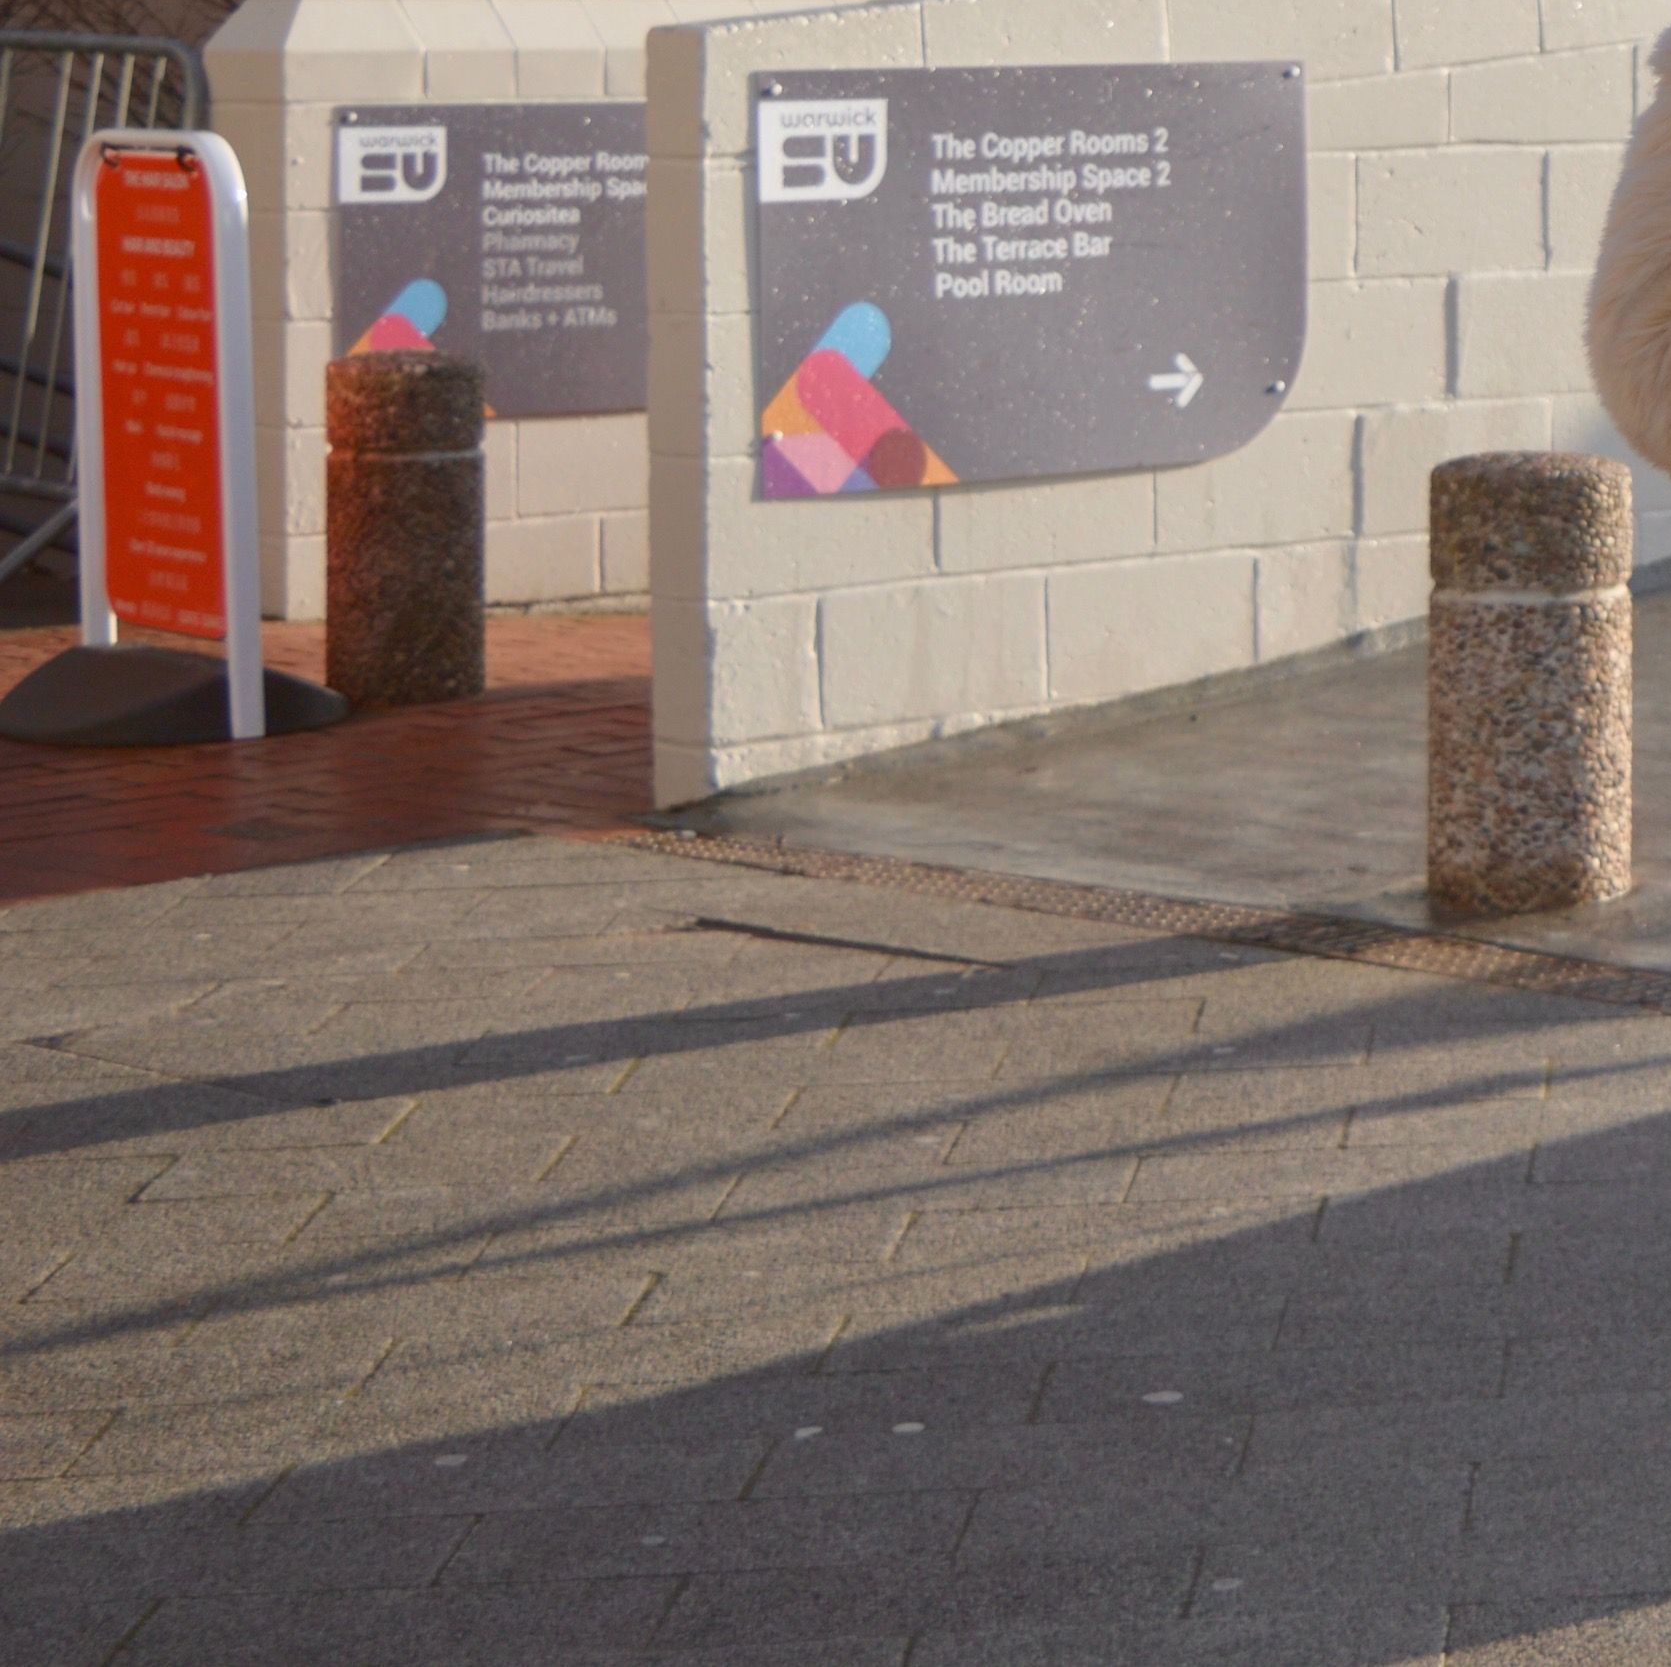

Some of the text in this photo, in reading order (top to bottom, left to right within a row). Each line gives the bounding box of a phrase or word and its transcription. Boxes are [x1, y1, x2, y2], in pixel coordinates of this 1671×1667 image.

[780, 107, 877, 128] warwick
[358, 134, 438, 147] warwick
[932, 126, 1170, 164] The Copper Rooms 2
[482, 152, 520, 175] The
[522, 153, 592, 177] Copper
[481, 179, 602, 202] Membership
[931, 160, 1172, 196] Membership Space 2
[481, 204, 582, 228] Curiositea
[931, 198, 1113, 230] The Bread Oven
[481, 231, 582, 255] Pharmacy
[931, 231, 1114, 264] The Terrace Bar
[482, 255, 584, 280] STA Travel
[481, 282, 604, 306] Hairdressers
[934, 269, 1064, 300] Pool Room
[481, 308, 543, 332] Banks
[563, 306, 619, 328] ATMs
